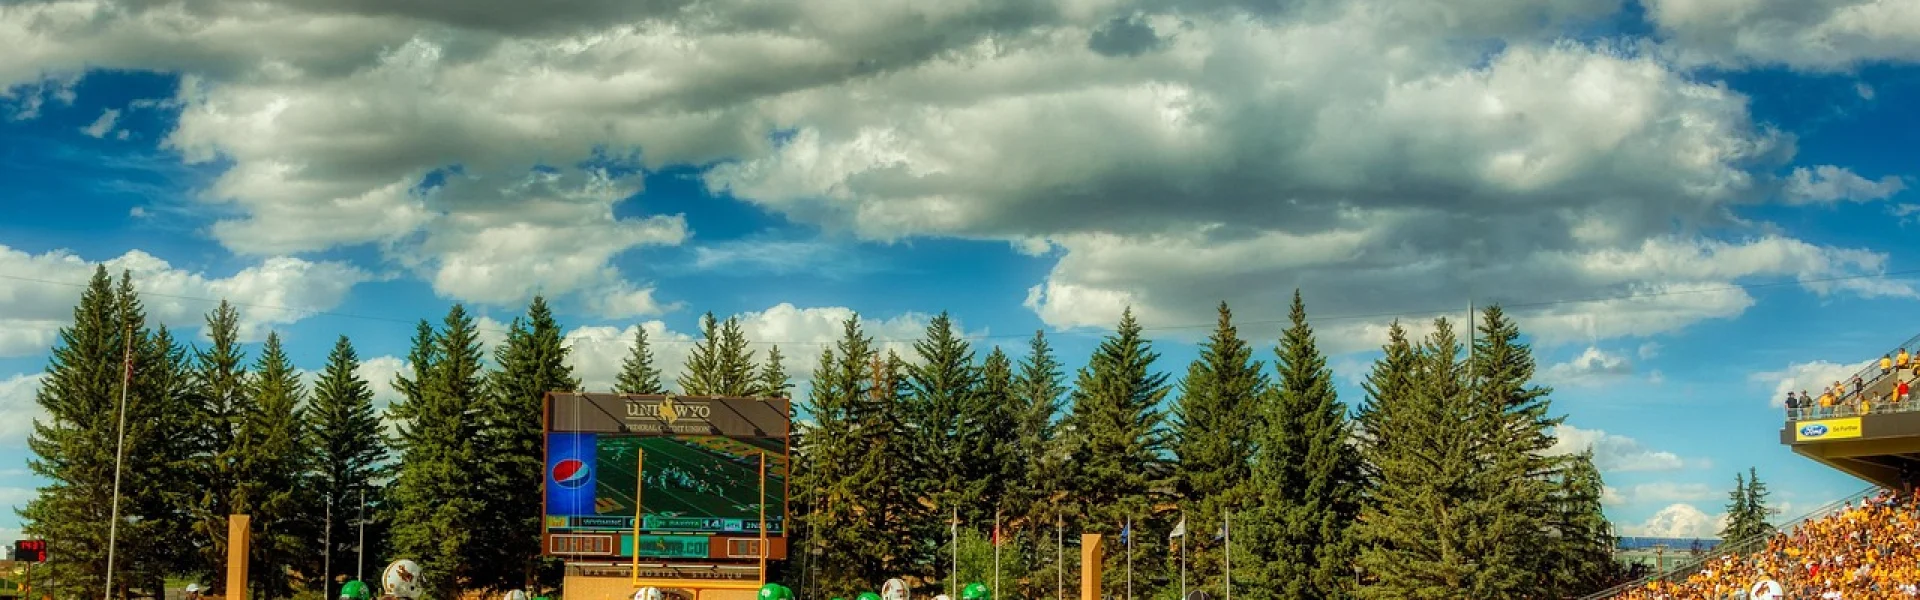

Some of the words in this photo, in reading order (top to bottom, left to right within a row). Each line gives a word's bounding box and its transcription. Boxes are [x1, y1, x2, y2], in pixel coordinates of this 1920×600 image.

[674, 404, 711, 418] WYO
[658, 424, 685, 432] CDIT
[685, 425, 711, 433] UNION
[702, 519, 721, 529] 14
[692, 571, 742, 580] STADIUM
